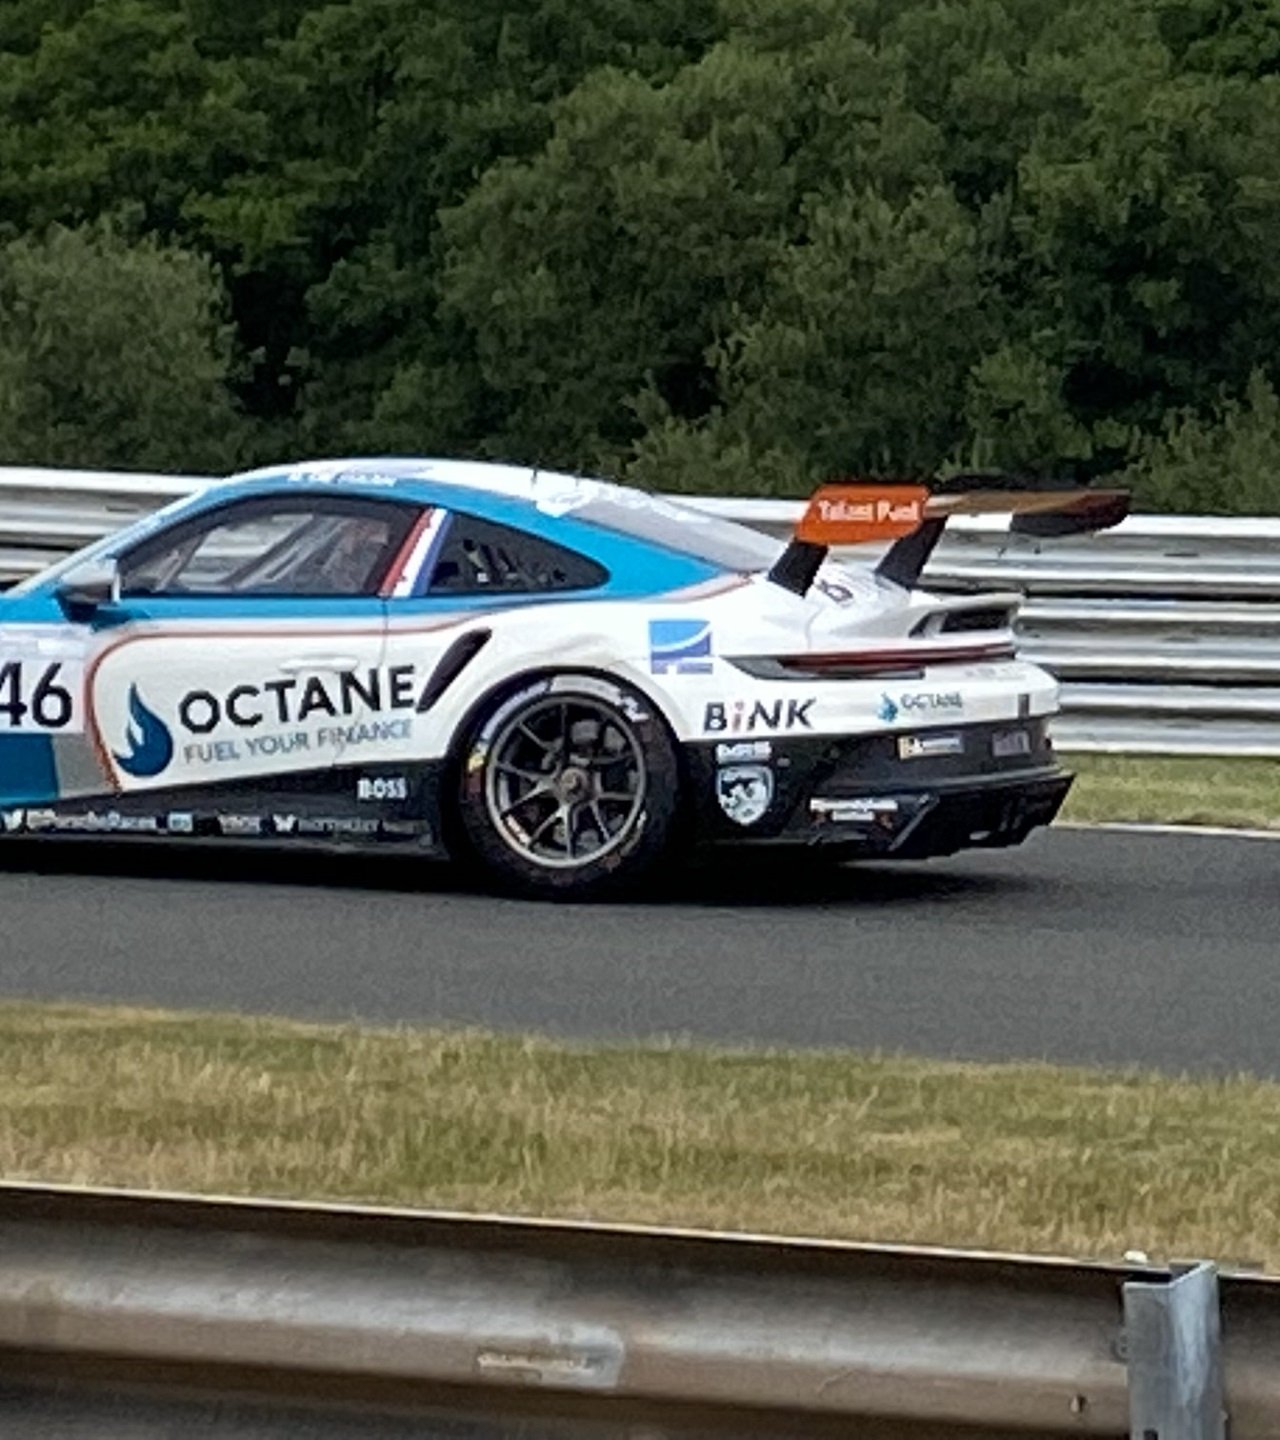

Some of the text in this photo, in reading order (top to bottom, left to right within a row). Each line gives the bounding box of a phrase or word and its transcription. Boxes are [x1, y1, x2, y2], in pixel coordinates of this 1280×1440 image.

[0, 662, 72, 728] 46
[179, 665, 416, 734] OCTANE
[184, 717, 414, 764] FUEL YOUR FINANCE
